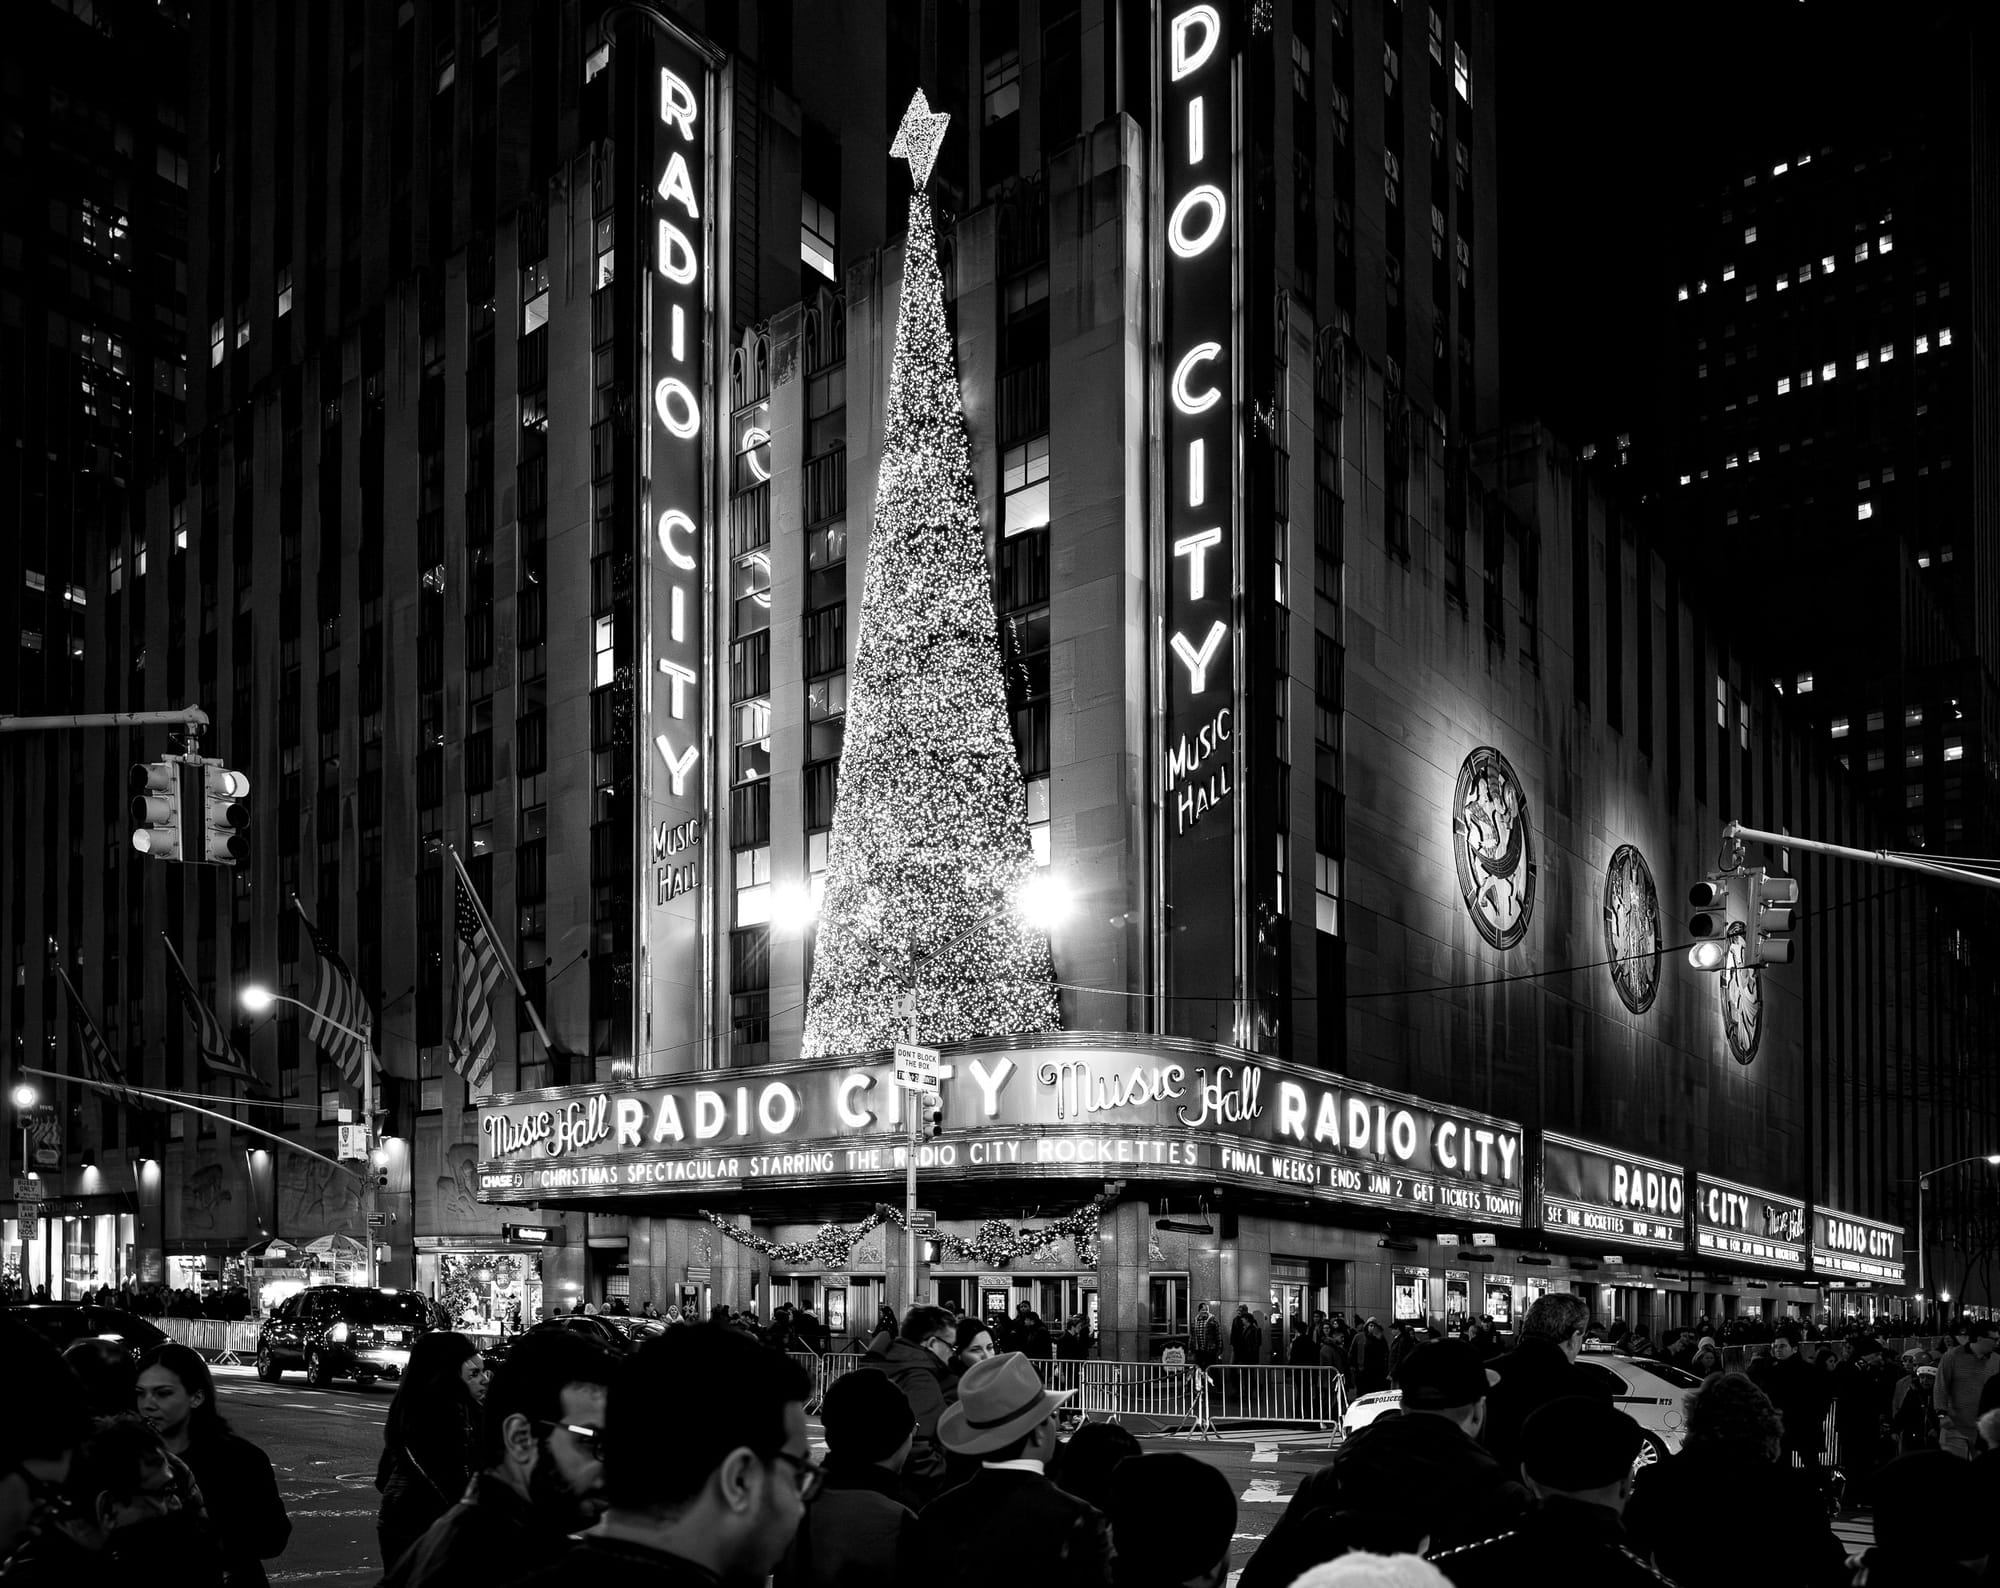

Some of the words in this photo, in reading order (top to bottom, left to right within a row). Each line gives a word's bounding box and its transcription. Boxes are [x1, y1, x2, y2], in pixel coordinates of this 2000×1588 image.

[655, 66, 700, 439] RADIO
[1170, 341, 1227, 695] CITY
[656, 509, 700, 796] CITY
[905, 1059, 917, 1068] THE
[918, 1061, 930, 1070] BOX
[917, 1052, 937, 1063] BLOCK
[616, 1082, 798, 1147] RADIO
[1037, 1060, 1186, 1119] Music
[1177, 1065, 1263, 1127] Hall
[484, 1111, 550, 1159] Music
[546, 1093, 610, 1157] Hall
[1279, 1080, 1416, 1161] RADIO
[1436, 1120, 1517, 1180] CITY
[482, 1174, 513, 1188] CHASE
[541, 1166, 618, 1187] CHRISTMAS
[627, 1159, 739, 1183] SPECTACULAR
[750, 1152, 834, 1177] STARRING
[846, 1151, 880, 1170] THE
[970, 1141, 1020, 1165] CITY
[1037, 1139, 1198, 1166] ROCKETTES
[1221, 1149, 1265, 1176] FINAL
[1271, 1157, 1321, 1185] WEEKS!
[1330, 1170, 1362, 1192] ENDS
[1368, 1174, 1391, 1196] JAN
[1396, 1180, 1404, 1198] 2
[1413, 1182, 1435, 1203] GET
[1440, 1187, 1481, 1210] TICKETS
[1613, 1165, 1682, 1214] RADIO
[1548, 1206, 1563, 1223] SEE
[1566, 1208, 1580, 1226] THE
[1584, 1212, 1624, 1233] ROCKETTES
[1632, 1221, 1648, 1236] NOW
[1654, 1225, 1667, 1240] JAN
[1708, 1188, 1749, 1229] CITY
[1828, 1219, 1867, 1254] RADIO
[1869, 1229, 1895, 1259] CITY
